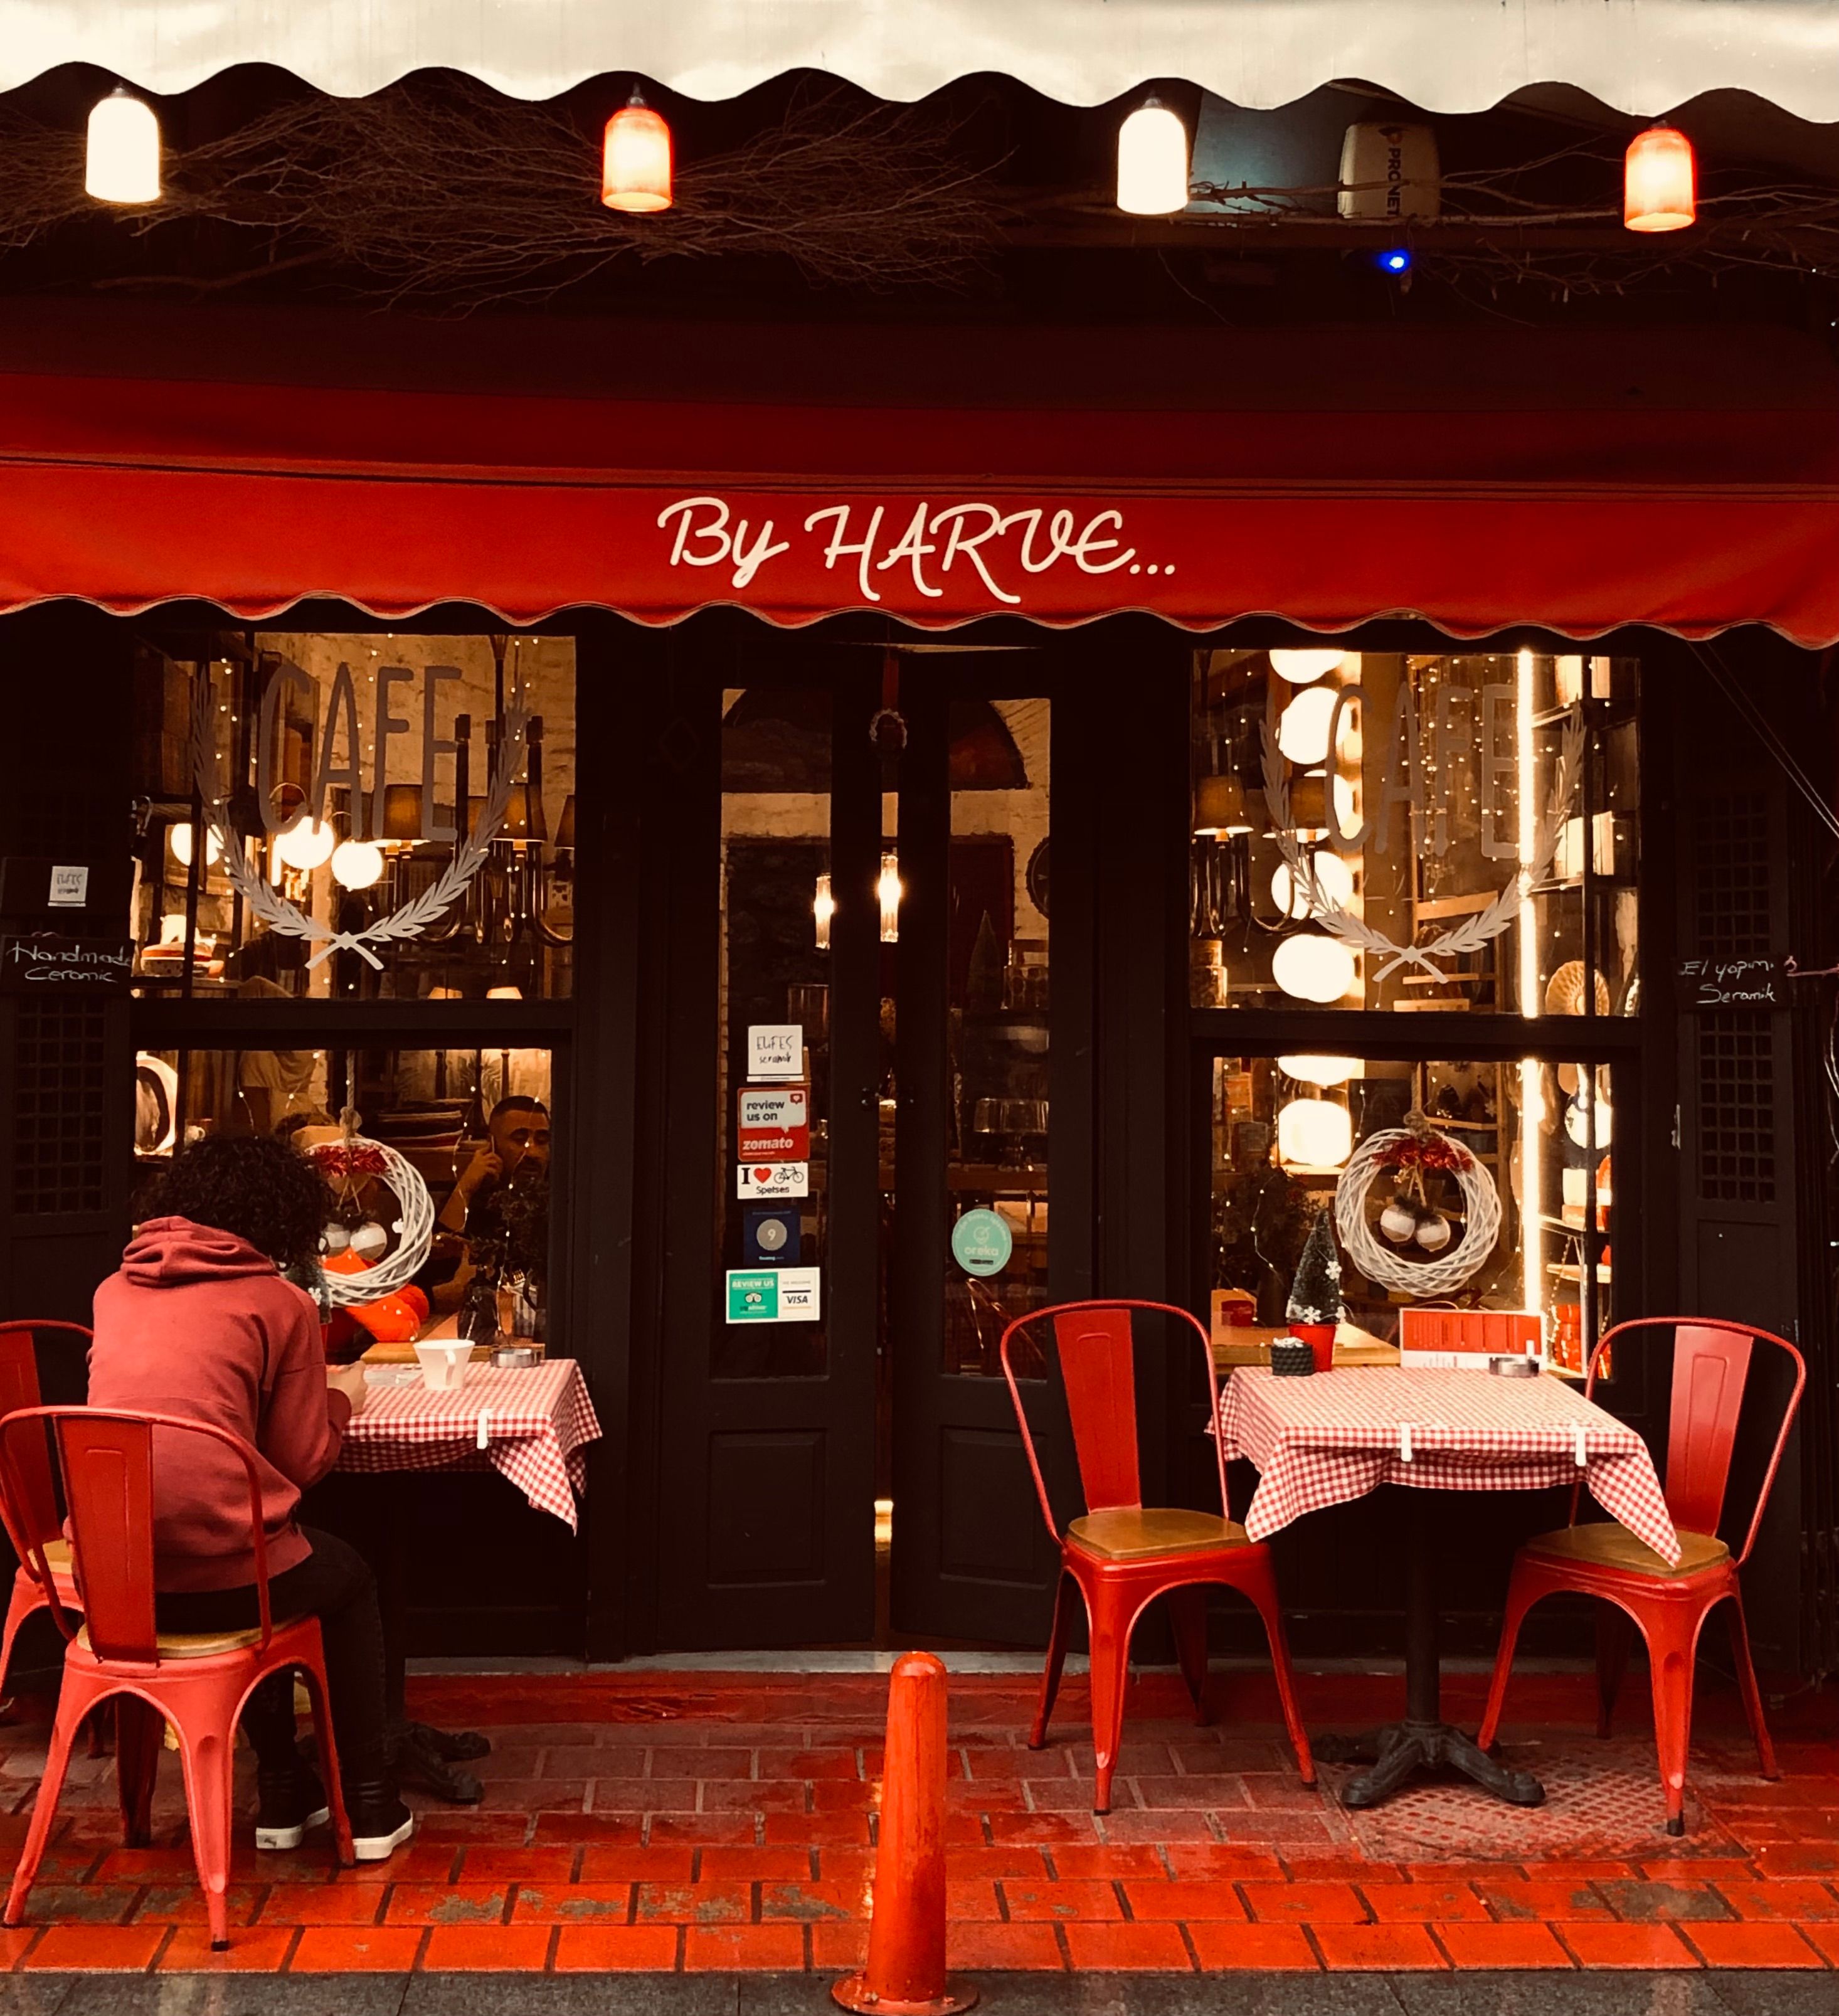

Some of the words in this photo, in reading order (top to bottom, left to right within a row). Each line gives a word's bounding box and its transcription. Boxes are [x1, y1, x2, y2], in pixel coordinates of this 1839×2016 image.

[1387, 147, 1401, 216] PRONET
[657, 497, 790, 588] By
[258, 661, 462, 842] CAFE
[1324, 682, 1524, 858] CAFE
[24, 965, 119, 984] Ceramic
[1696, 982, 1776, 1004] Seramik
[746, 1100, 785, 1110] review
[746, 1113, 761, 1122] us
[762, 1112, 778, 1122] on
[742, 1137, 794, 1150] zomato
[741, 1167, 751, 1185] I
[767, 1228, 776, 1241] 9
[731, 1280, 762, 1288] REVIEW
[763, 1278, 775, 1287] US
[786, 1295, 808, 1304] VISA
